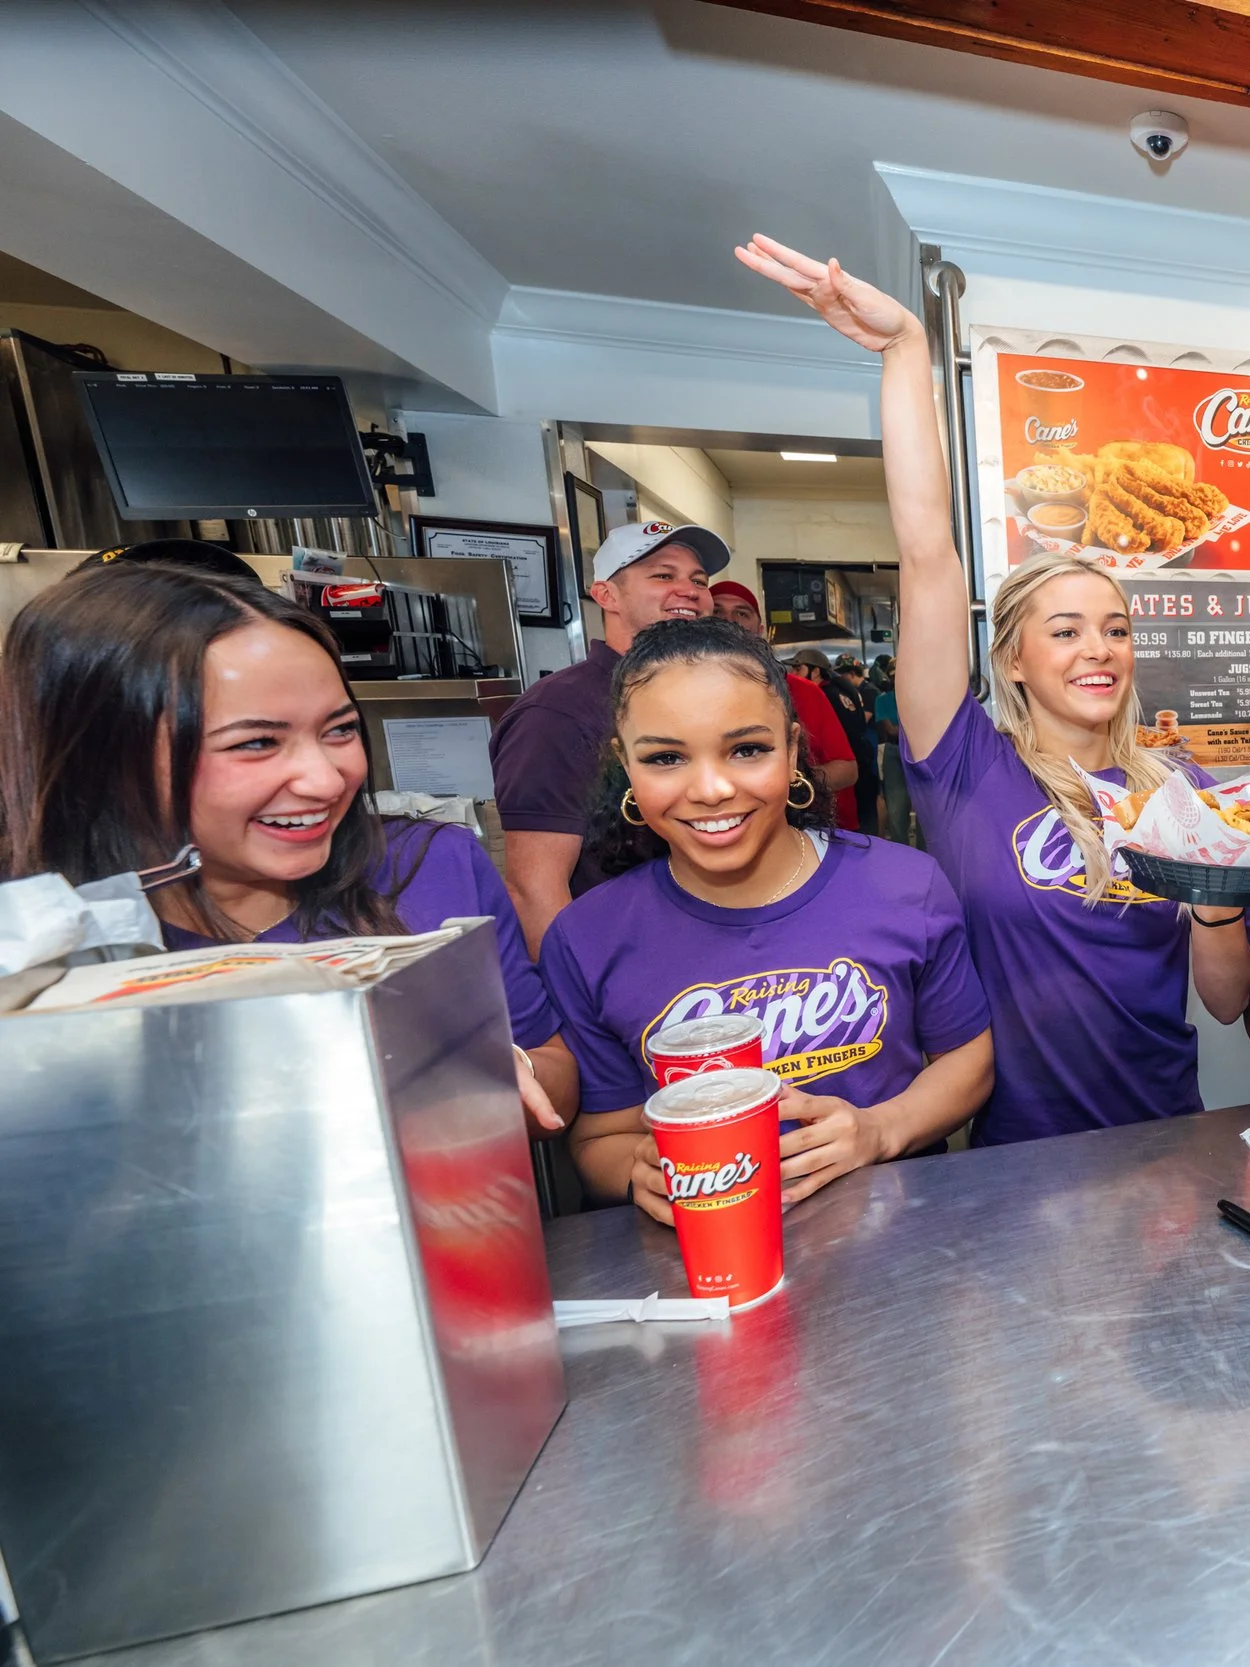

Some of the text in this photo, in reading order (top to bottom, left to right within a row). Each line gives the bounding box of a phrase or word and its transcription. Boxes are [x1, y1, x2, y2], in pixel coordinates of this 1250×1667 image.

[1024, 416, 1079, 444] Cane's
[1129, 594, 1194, 616] ATES
[1206, 595, 1224, 616] &
[1132, 632, 1167, 645] 39.99
[1187, 631, 1206, 645] 50
[1134, 650, 1160, 658] NGERS
[1197, 650, 1213, 658] Each
[1215, 650, 1247, 658] additional
[729, 975, 811, 1010] Raising
[806, 1045, 866, 1069] FINGERS
[676, 1162, 721, 1173] Raising
[716, 1190, 753, 1206] FINGERS
